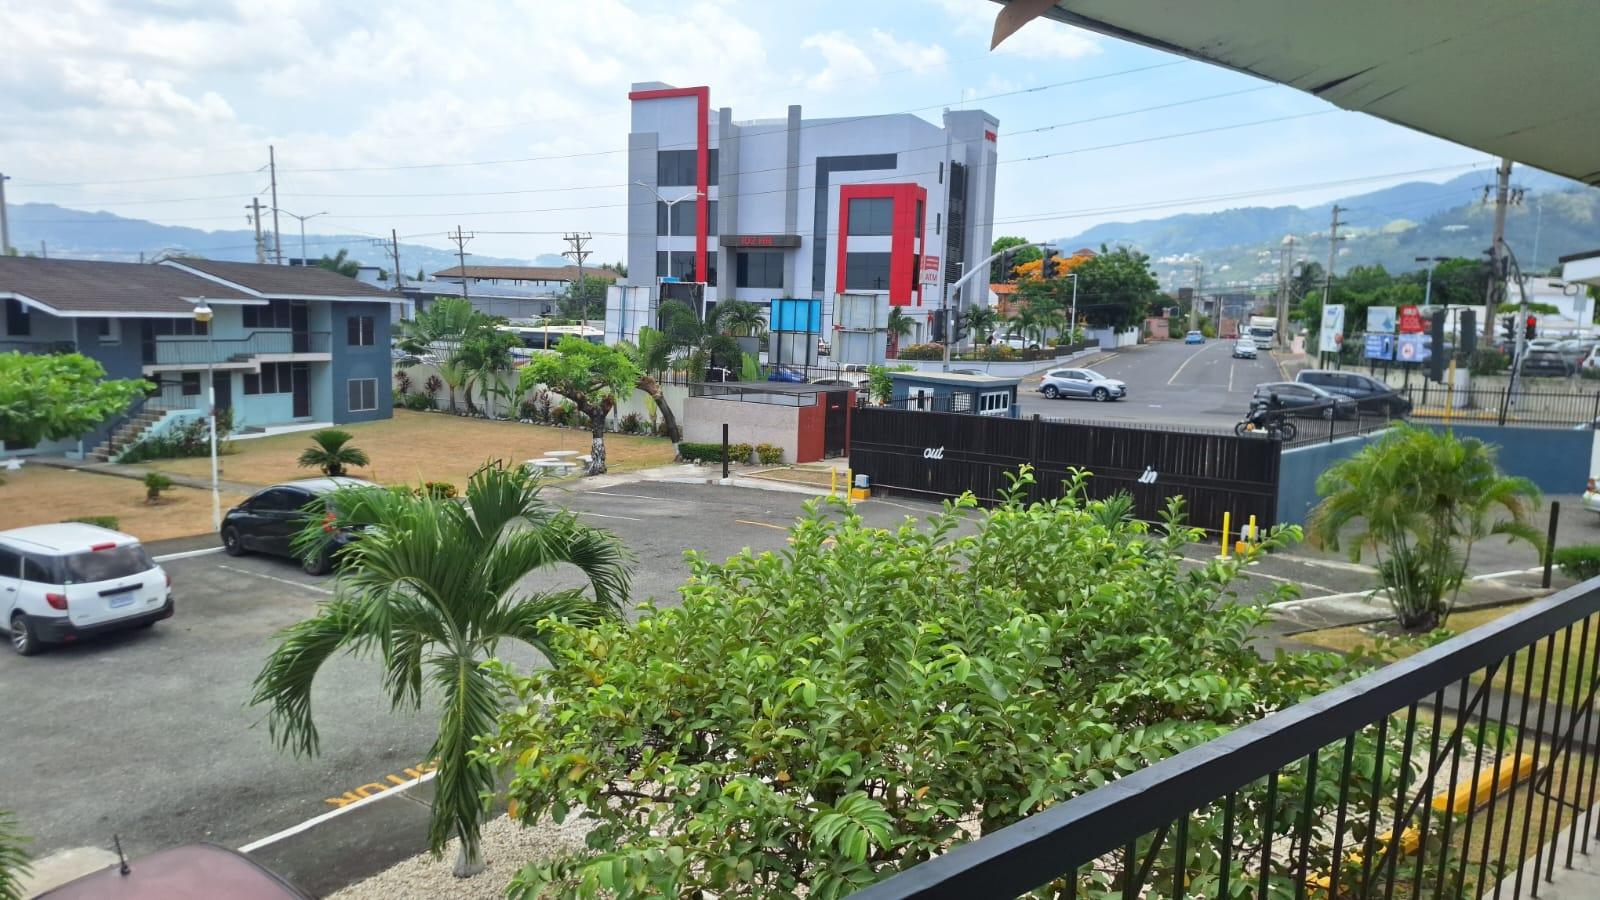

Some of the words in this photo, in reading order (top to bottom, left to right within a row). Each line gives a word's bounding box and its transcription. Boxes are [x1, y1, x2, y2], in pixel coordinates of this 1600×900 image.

[925, 272, 938, 281] ATM
[923, 445, 945, 460] out
[1137, 465, 1158, 484] in
